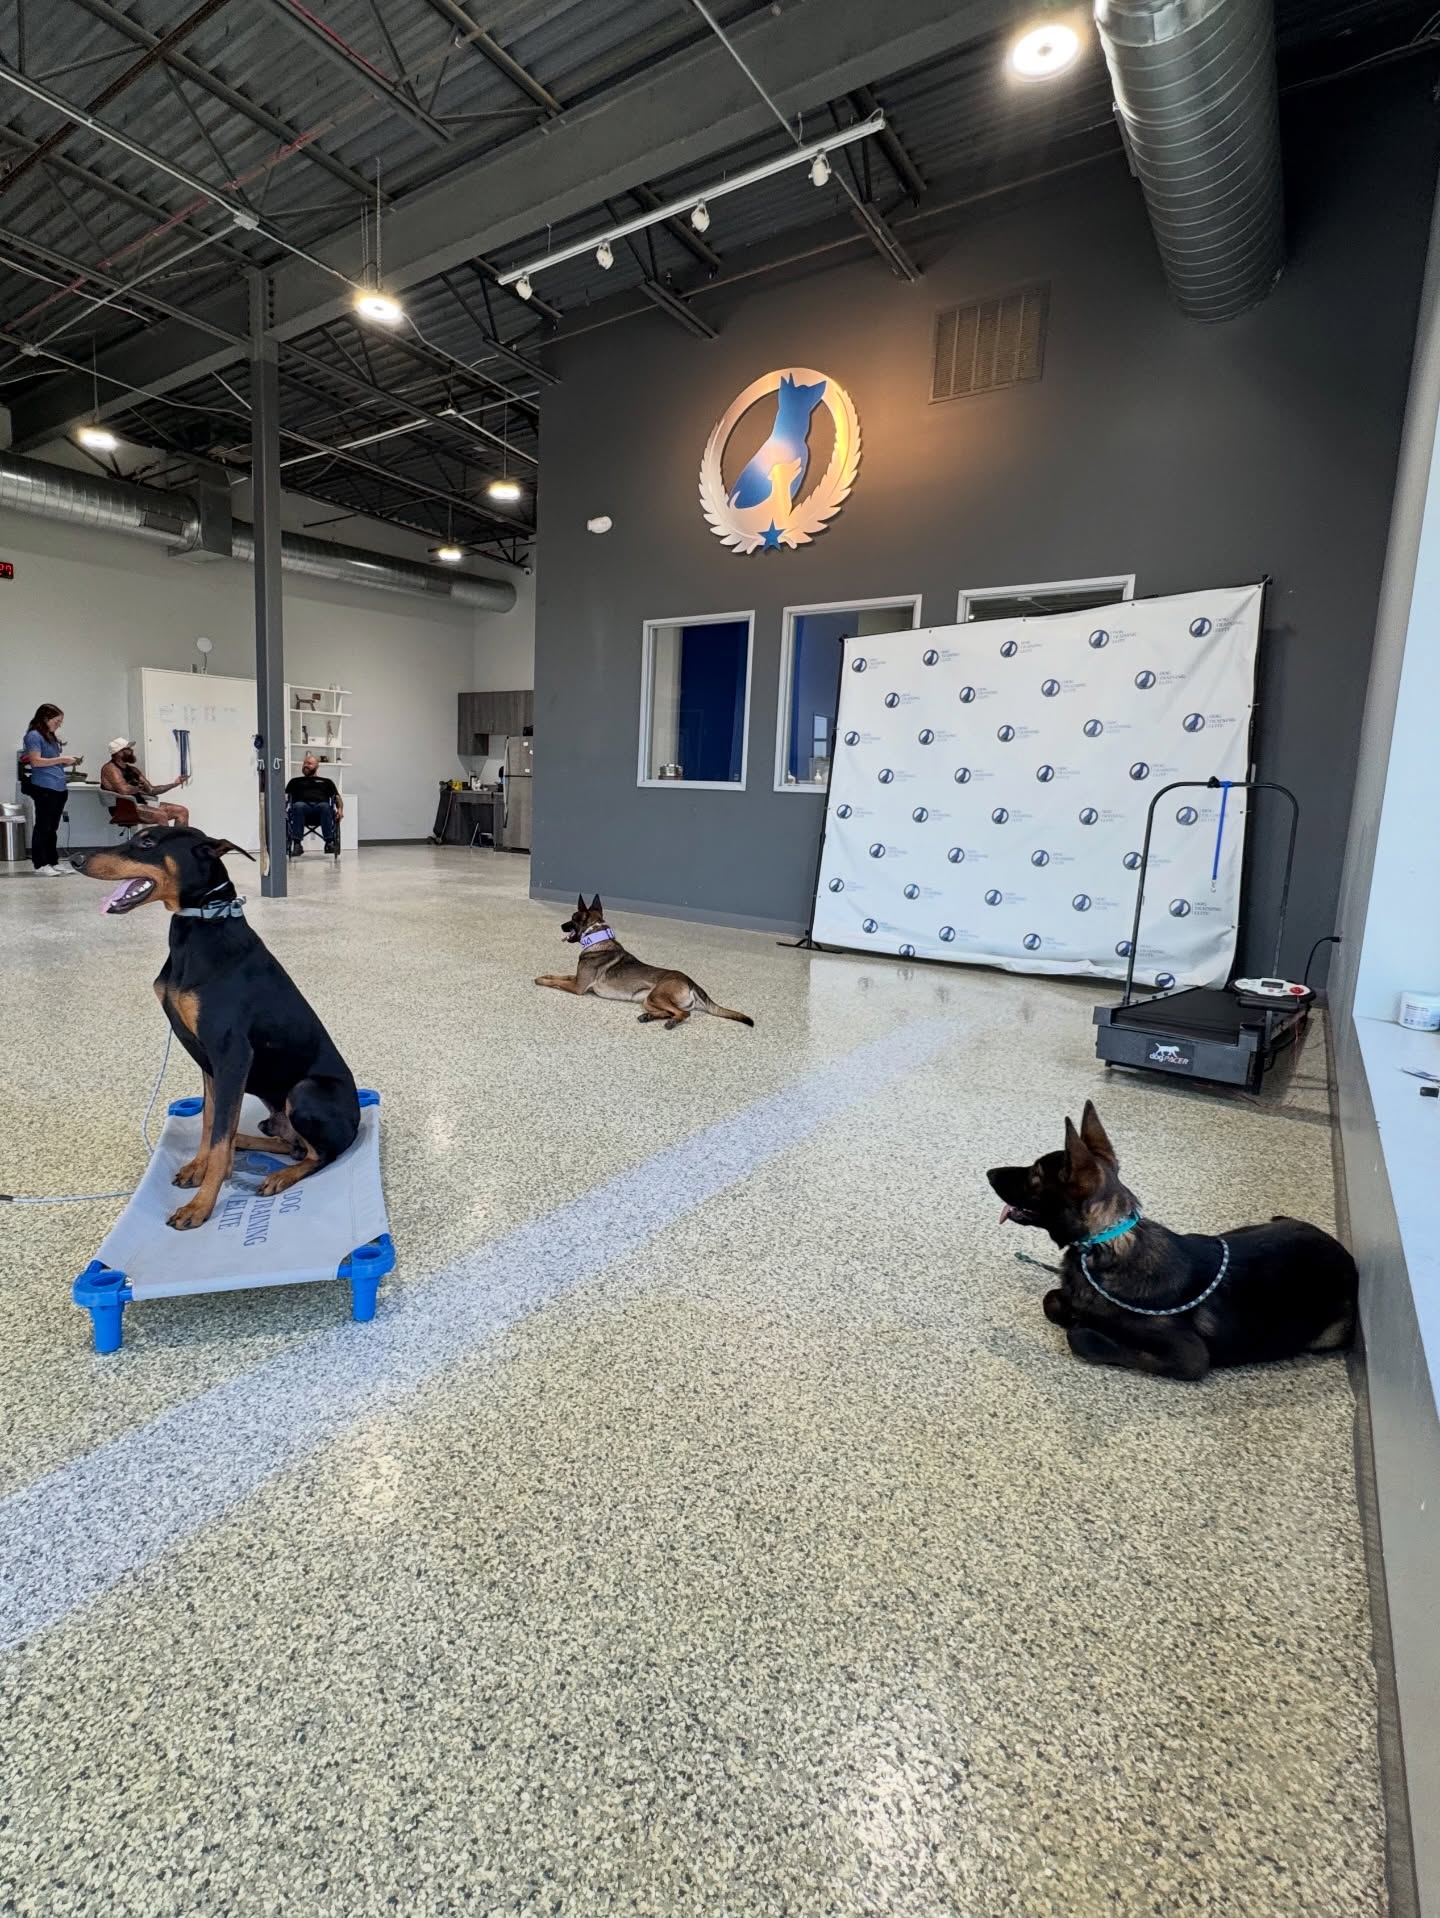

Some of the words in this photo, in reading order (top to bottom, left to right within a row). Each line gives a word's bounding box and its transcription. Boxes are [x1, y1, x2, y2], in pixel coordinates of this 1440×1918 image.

[218, 1199, 248, 1230] ELITE
[279, 1190, 303, 1213] DOG
[243, 1196, 276, 1246] TRAINING
